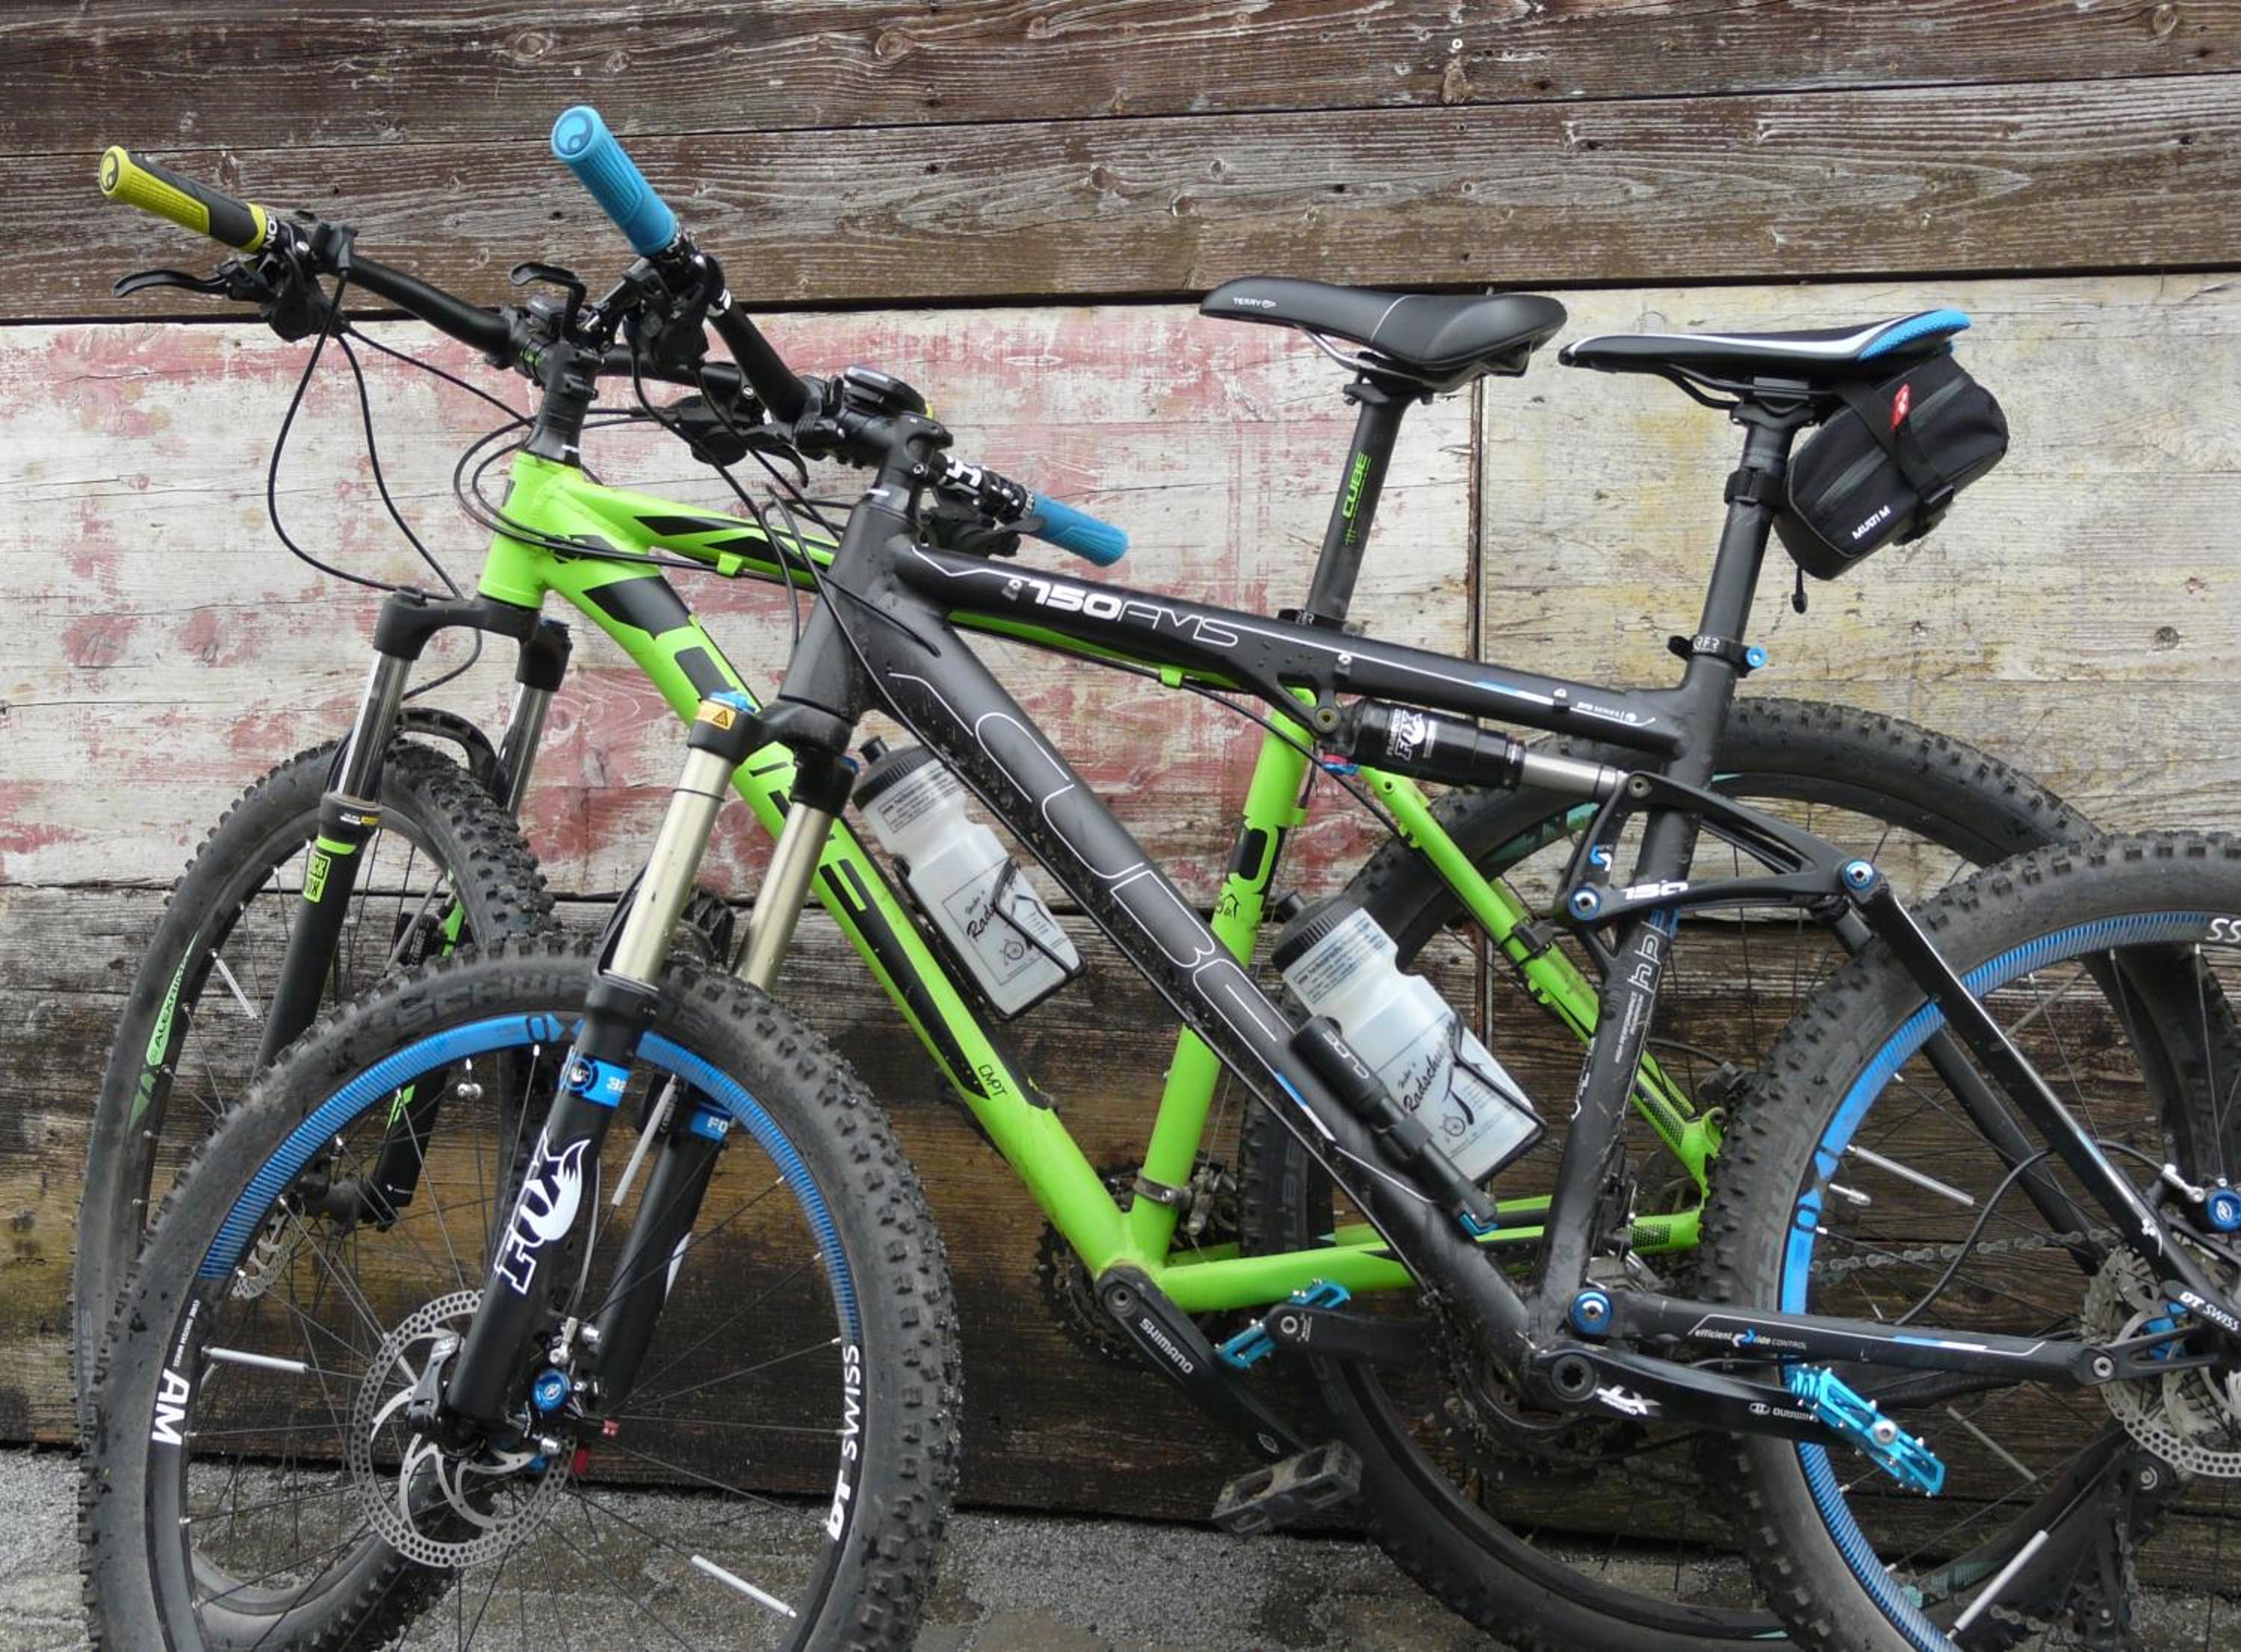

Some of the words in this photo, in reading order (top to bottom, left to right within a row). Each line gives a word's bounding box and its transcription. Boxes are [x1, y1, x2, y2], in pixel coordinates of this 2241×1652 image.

[1342, 452, 1369, 518] CUBE
[1878, 505, 1891, 518] M
[1395, 709, 1426, 761] FOX
[976, 712, 1295, 1072] CUBE
[1619, 881, 1688, 900] 150
[979, 1064, 1008, 1096] CMPT
[707, 1117, 729, 1134] FO
[494, 1126, 591, 1295] FOX
[1694, 1328, 1733, 1341] efficient
[1752, 1335, 1772, 1345] ride
[2180, 1291, 2206, 1308] DT
[2203, 1304, 2239, 1332] SWISS
[1139, 1317, 1194, 1374] SHIMANO
[152, 1367, 190, 1445] AM
[827, 1469, 852, 1541] DT
[842, 1344, 861, 1461] SWISS
